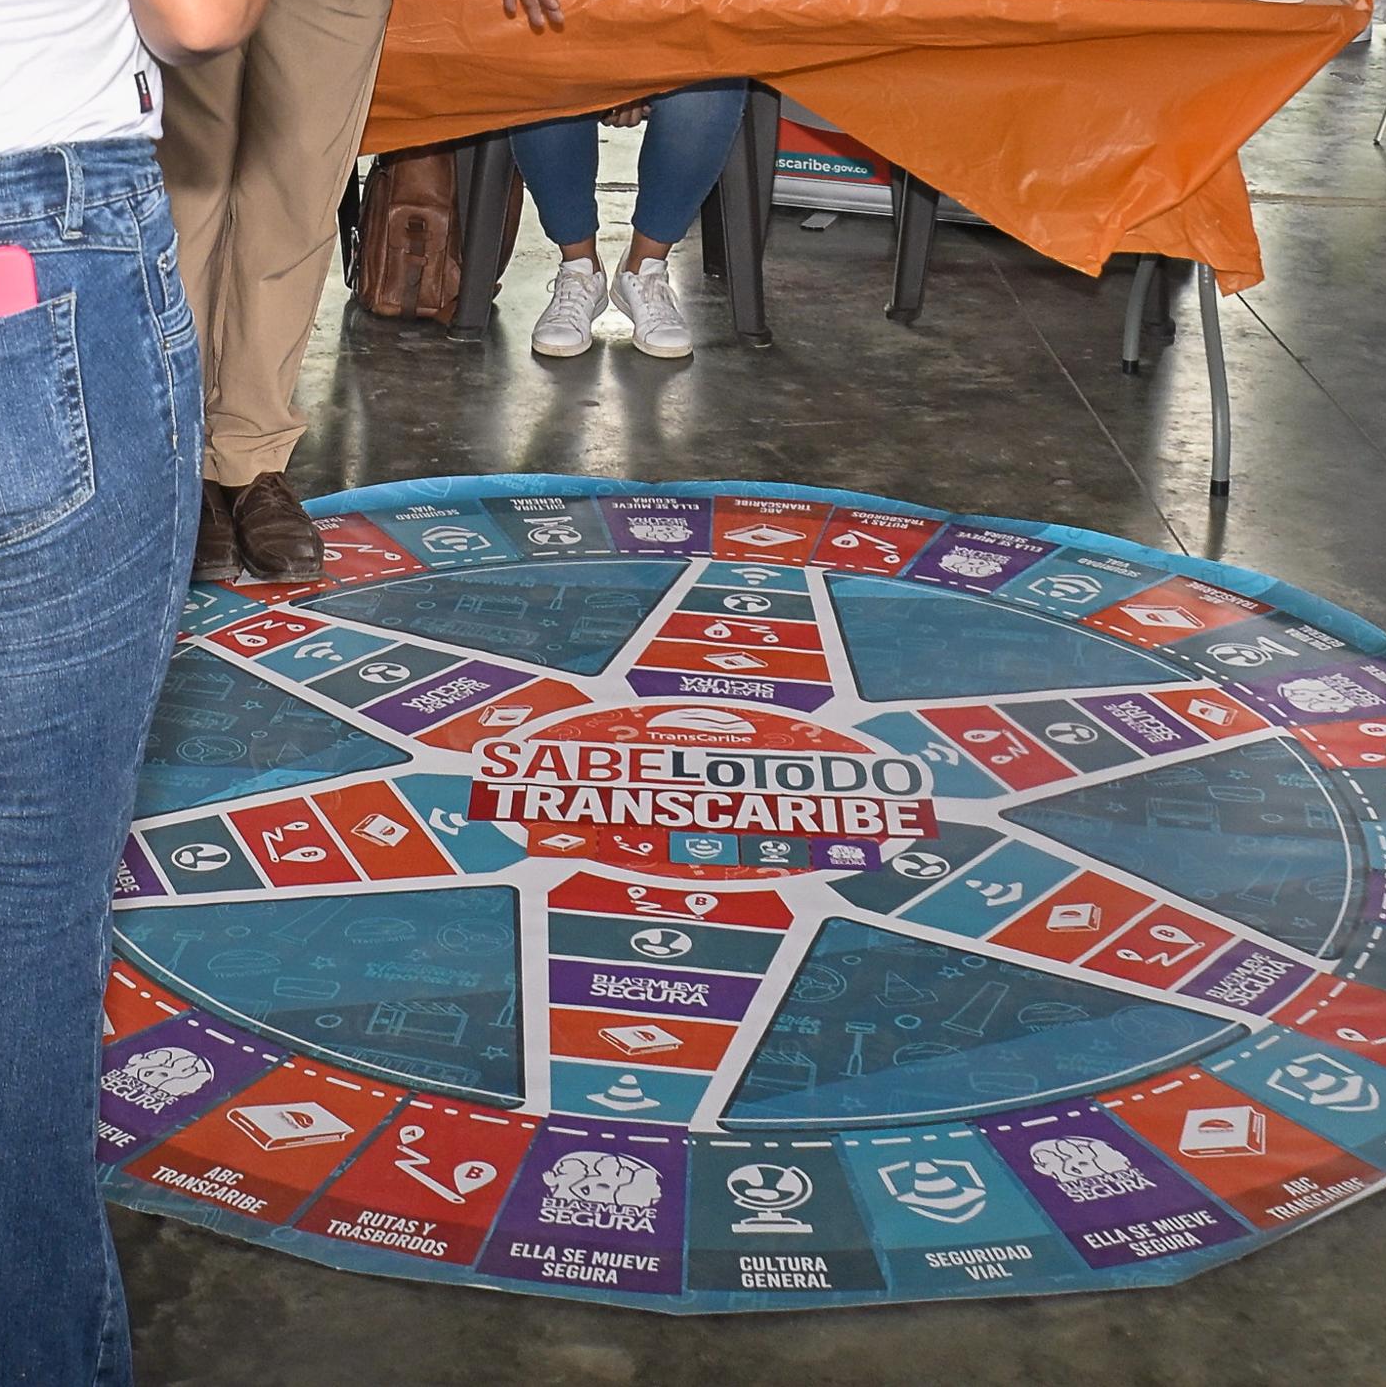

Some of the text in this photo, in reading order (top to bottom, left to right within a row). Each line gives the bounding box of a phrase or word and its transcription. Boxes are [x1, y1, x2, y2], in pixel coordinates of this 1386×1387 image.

[775, 158, 868, 174] scaribe.gov.co
[395, 508, 460, 521] SEGURIDAD
[408, 504, 434, 513] VIAL
[734, 499, 812, 511] TRANSCARIBE
[850, 511, 925, 526] TRASBORDOS
[873, 519, 908, 529] RUTAS
[955, 532, 1044, 553] ELLA SE MUEVE
[983, 530, 1029, 544] SEGURA
[401, 677, 478, 709] SEGURA
[681, 676, 775, 692] SEGURA
[1119, 700, 1181, 740] SEGURA
[647, 731, 754, 744] TransCaribe
[481, 741, 924, 796] SABELOTODO
[488, 783, 926, 836] TRANSCARIBE
[695, 897, 707, 907] B
[1157, 929, 1175, 937] B
[1223, 960, 1296, 1007] SEGURA
[590, 984, 709, 1007] SEGURA
[101, 1075, 165, 1114] SEGURA
[98, 1120, 137, 1148] UEVE
[204, 1166, 244, 1186] ABC
[465, 1166, 484, 1180] B
[151, 1166, 269, 1214] TRANSCARIBE
[1066, 1176, 1157, 1203] SEGURA
[1282, 1177, 1319, 1197] ABC
[1266, 1177, 1367, 1221] TRANSCARIBE
[358, 1210, 437, 1235] RUTAS Y
[538, 1207, 655, 1234] SEGURA
[1083, 1210, 1217, 1250] ELLA SE MUEVE
[326, 1219, 449, 1257] TRASBORDOS
[1128, 1231, 1202, 1258] SEGURA
[510, 1242, 660, 1272] ELLA SE MUEVE
[739, 1256, 828, 1272] CULTURA
[925, 1245, 1033, 1268] SEGURIDAD
[542, 1262, 618, 1285] SEGURA
[741, 1272, 832, 1289] GENERAL
[965, 1263, 1013, 1281] VIAL
